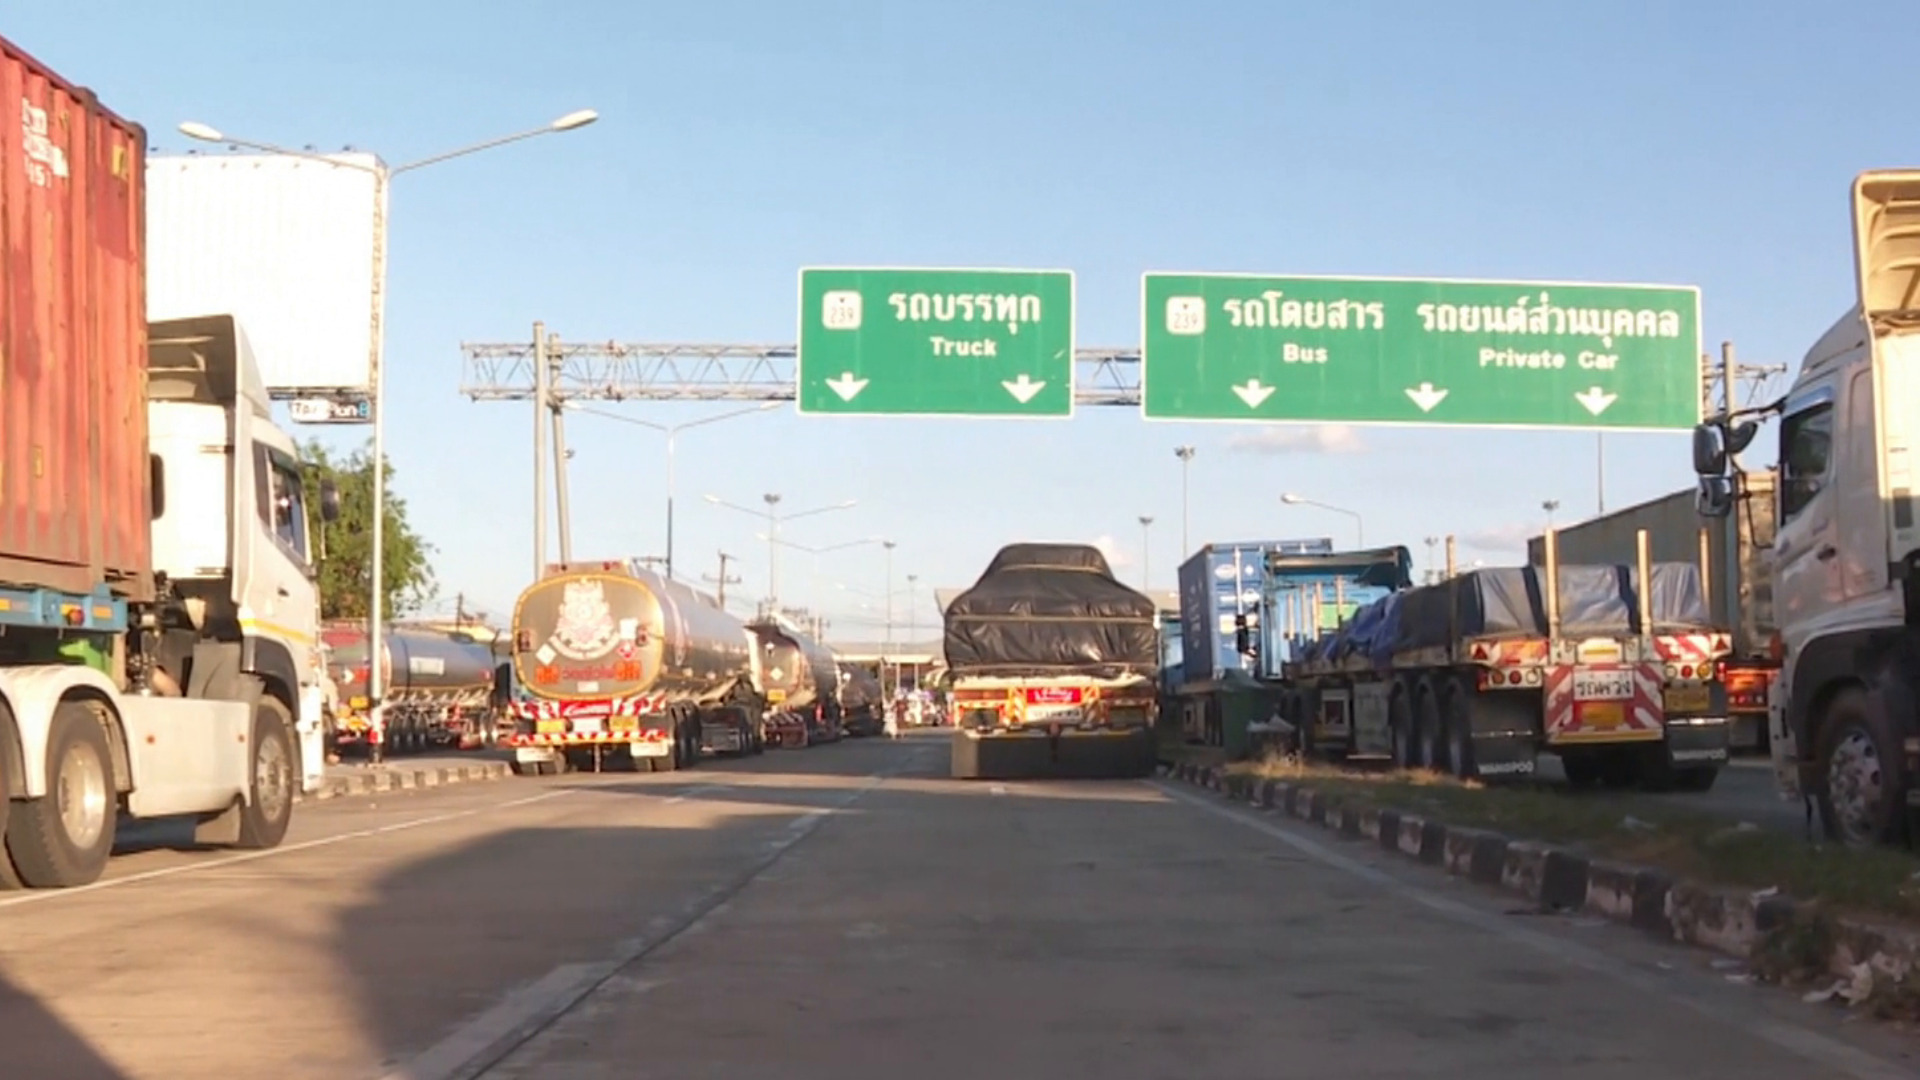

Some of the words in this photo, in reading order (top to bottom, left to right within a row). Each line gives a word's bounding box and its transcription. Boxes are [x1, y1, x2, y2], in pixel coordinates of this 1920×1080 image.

[888, 292, 1042, 334] รถบรรทุก
[1223, 290, 1385, 330] รถโดยสาร
[1416, 291, 1680, 349] รถยนต์ส่วนบุคคล
[930, 336, 997, 357] Truck
[1282, 342, 1328, 364] Bus
[1478, 346, 1567, 370] Private
[1577, 349, 1620, 372] Car
